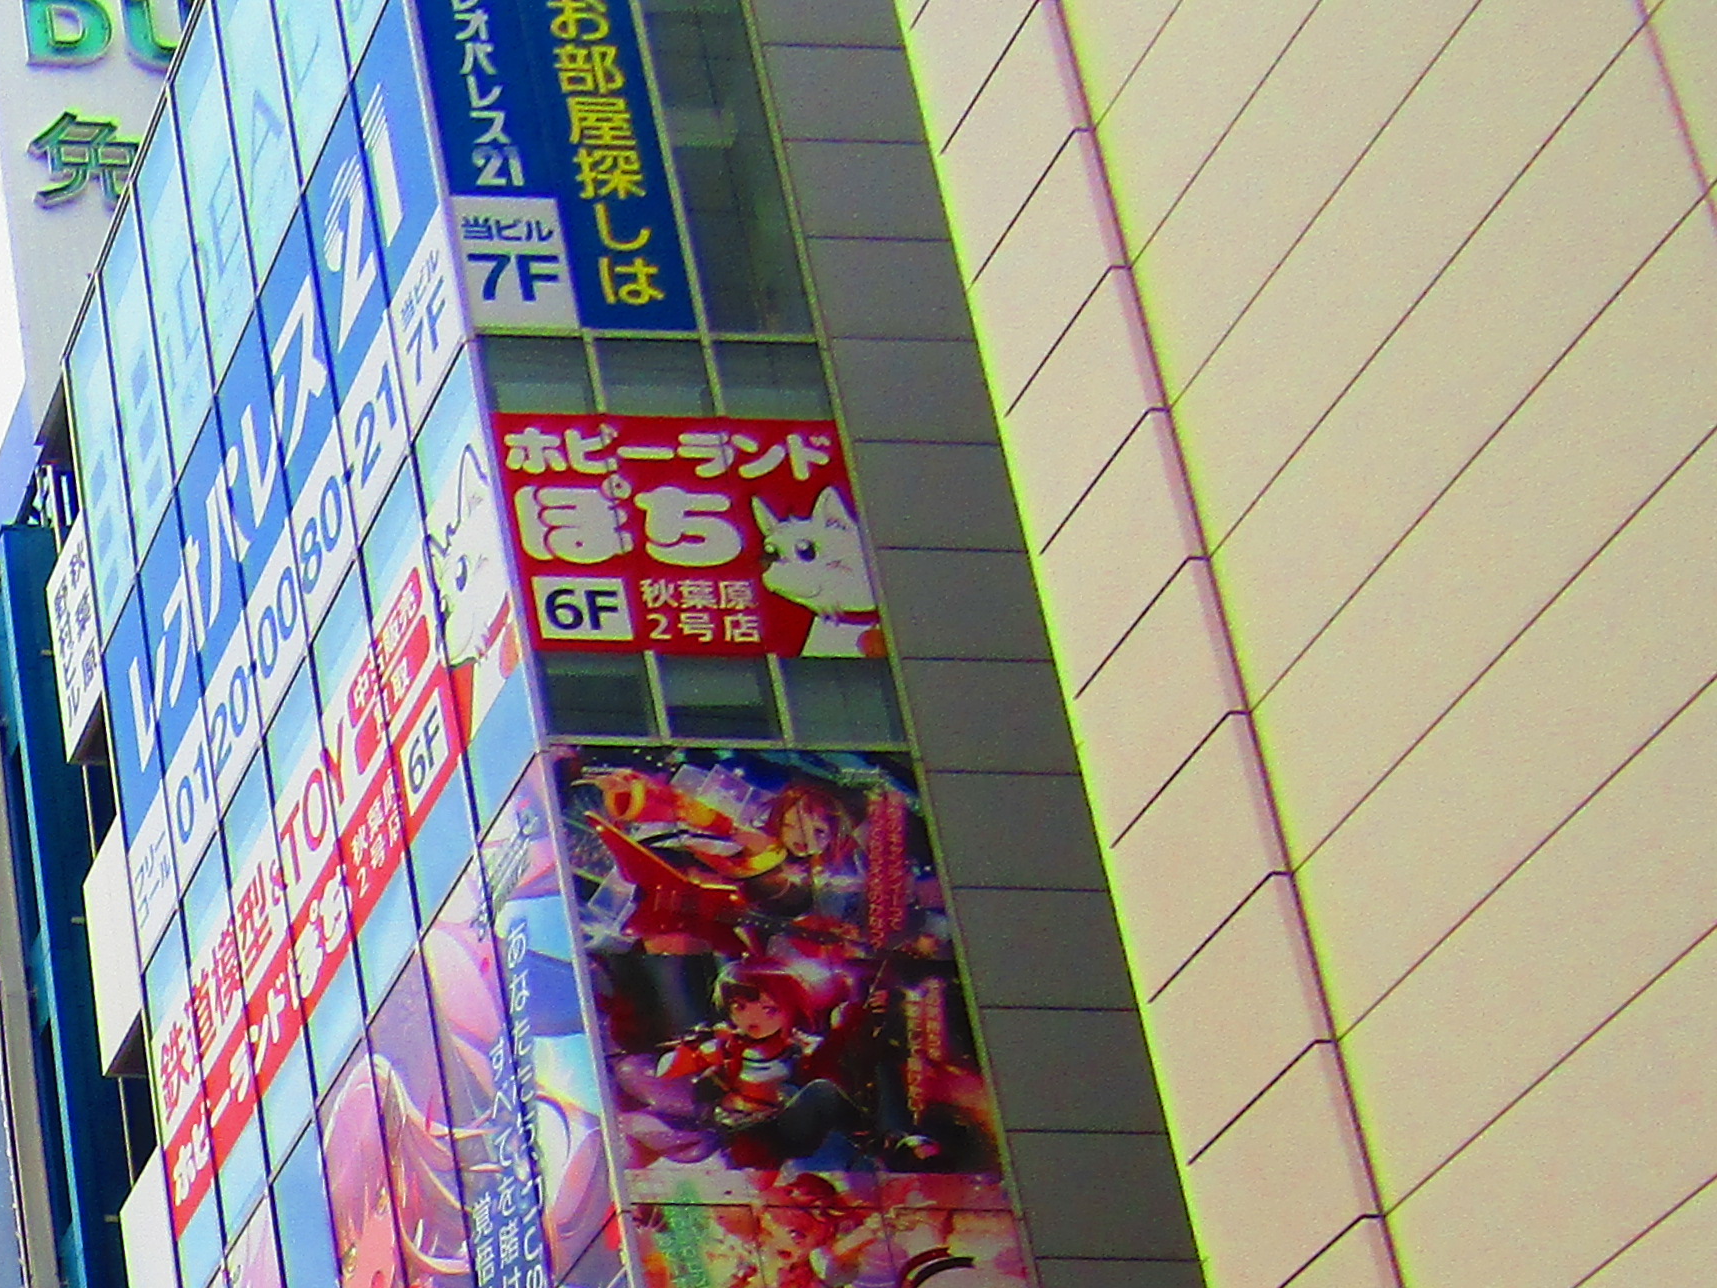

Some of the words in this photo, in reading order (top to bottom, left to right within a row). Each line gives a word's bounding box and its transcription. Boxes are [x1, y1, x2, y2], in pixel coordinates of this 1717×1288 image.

[461, 216, 554, 244] 当ビル
[467, 252, 561, 304] 7F
[406, 291, 450, 384] 7F
[504, 427, 833, 478] ホビーランド
[513, 474, 743, 568] ぽち
[545, 589, 621, 631] 6F
[640, 578, 757, 609] 秋葉原
[647, 611, 762, 644] 2号店
[408, 706, 442, 785] 6F
